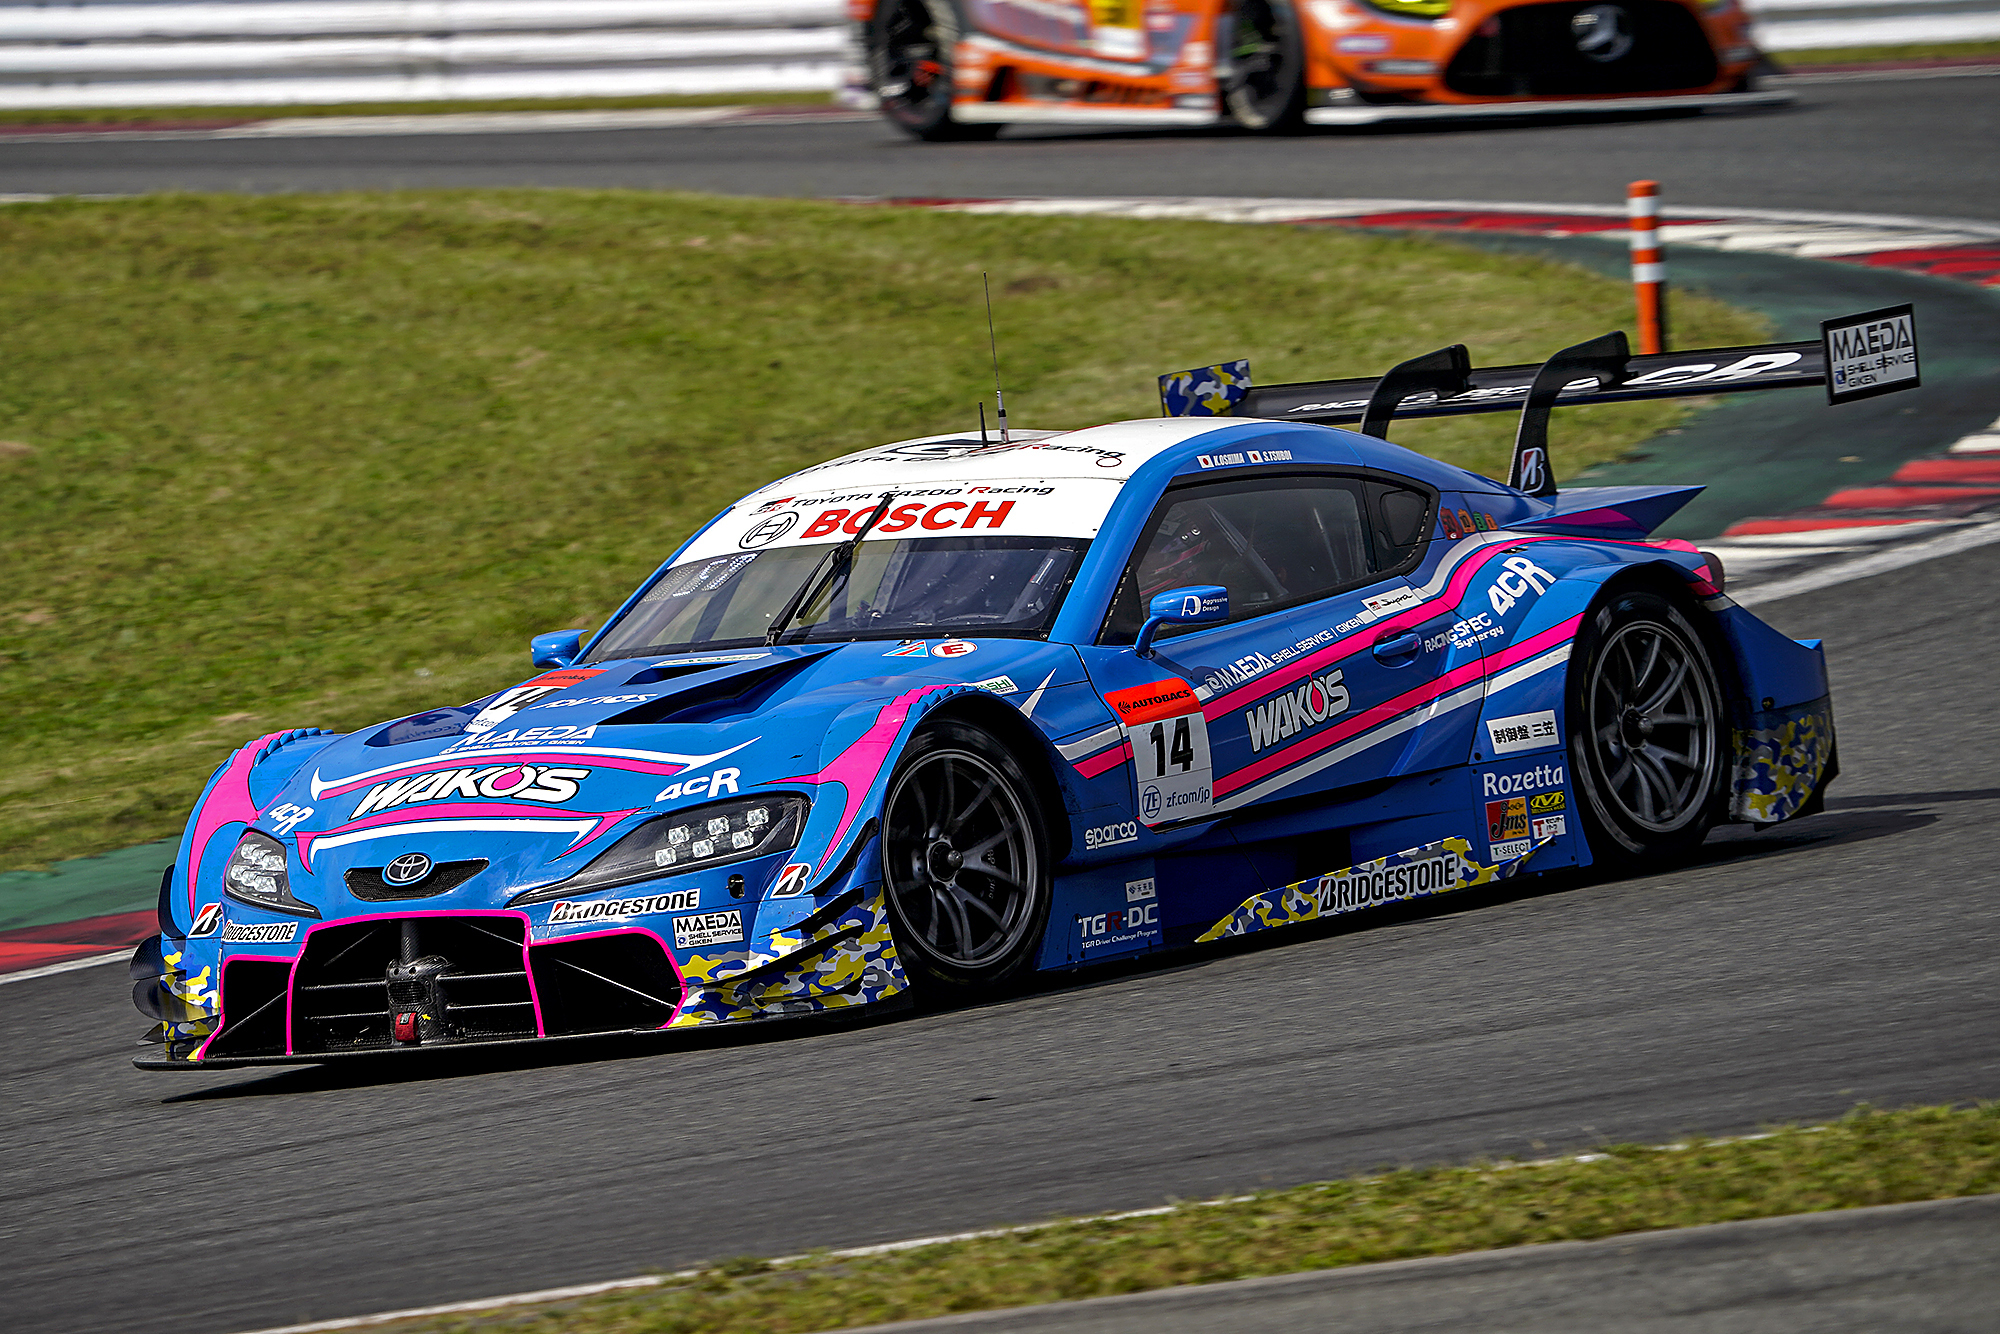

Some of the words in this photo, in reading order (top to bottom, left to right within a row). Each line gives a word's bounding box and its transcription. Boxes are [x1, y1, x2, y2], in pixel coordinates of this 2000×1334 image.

[1833, 319, 1912, 362] MAEDA
[1213, 452, 1245, 466] K.OSHIMA
[1262, 450, 1293, 462] S.TSUBOI
[792, 493, 873, 507] TOYOTA
[878, 487, 963, 498] GAZOO
[967, 486, 1055, 495] Racing
[799, 500, 1017, 539] BOSCH
[1487, 556, 1557, 617] 4CR
[1202, 597, 1228, 605] Aggressive
[1381, 594, 1413, 606] Supra
[1424, 628, 1459, 653] RACING
[1453, 611, 1492, 638] SPEC
[1454, 625, 1505, 649] Synergy
[1214, 652, 1276, 689] MAEDA
[1336, 616, 1364, 634] GIKEN
[1132, 689, 1192, 710] AUTOBACS
[1246, 669, 1351, 754] WAKO'S
[451, 724, 599, 748] MAEDA
[457, 742, 491, 752] SHELL
[491, 740, 541, 748] SERVICE
[1149, 716, 1195, 778] 14
[348, 762, 592, 822] WAKO'S
[653, 766, 742, 803] 4CR
[1483, 764, 1565, 797] Rozetta
[1166, 787, 1211, 808] zf.com/jp
[268, 802, 315, 836] 4CR
[1085, 821, 1137, 849] sparco
[1492, 842, 1530, 856] T-SELECT
[1319, 857, 1457, 913] BRIDGESTONE
[551, 890, 698, 922] BRIDGESTONE
[222, 920, 298, 941] BRIDGESTONE
[676, 912, 741, 933] MAEDA
[1078, 902, 1158, 938] TGR-DC
[688, 932, 712, 940] SHELL
[712, 928, 743, 937] SERVICE
[689, 938, 713, 946] GIKEN
[1081, 940, 1095, 949] TGR
[1095, 938, 1111, 946] Driver
[1111, 933, 1137, 943] Challenge
[1136, 929, 1158, 938] Program
